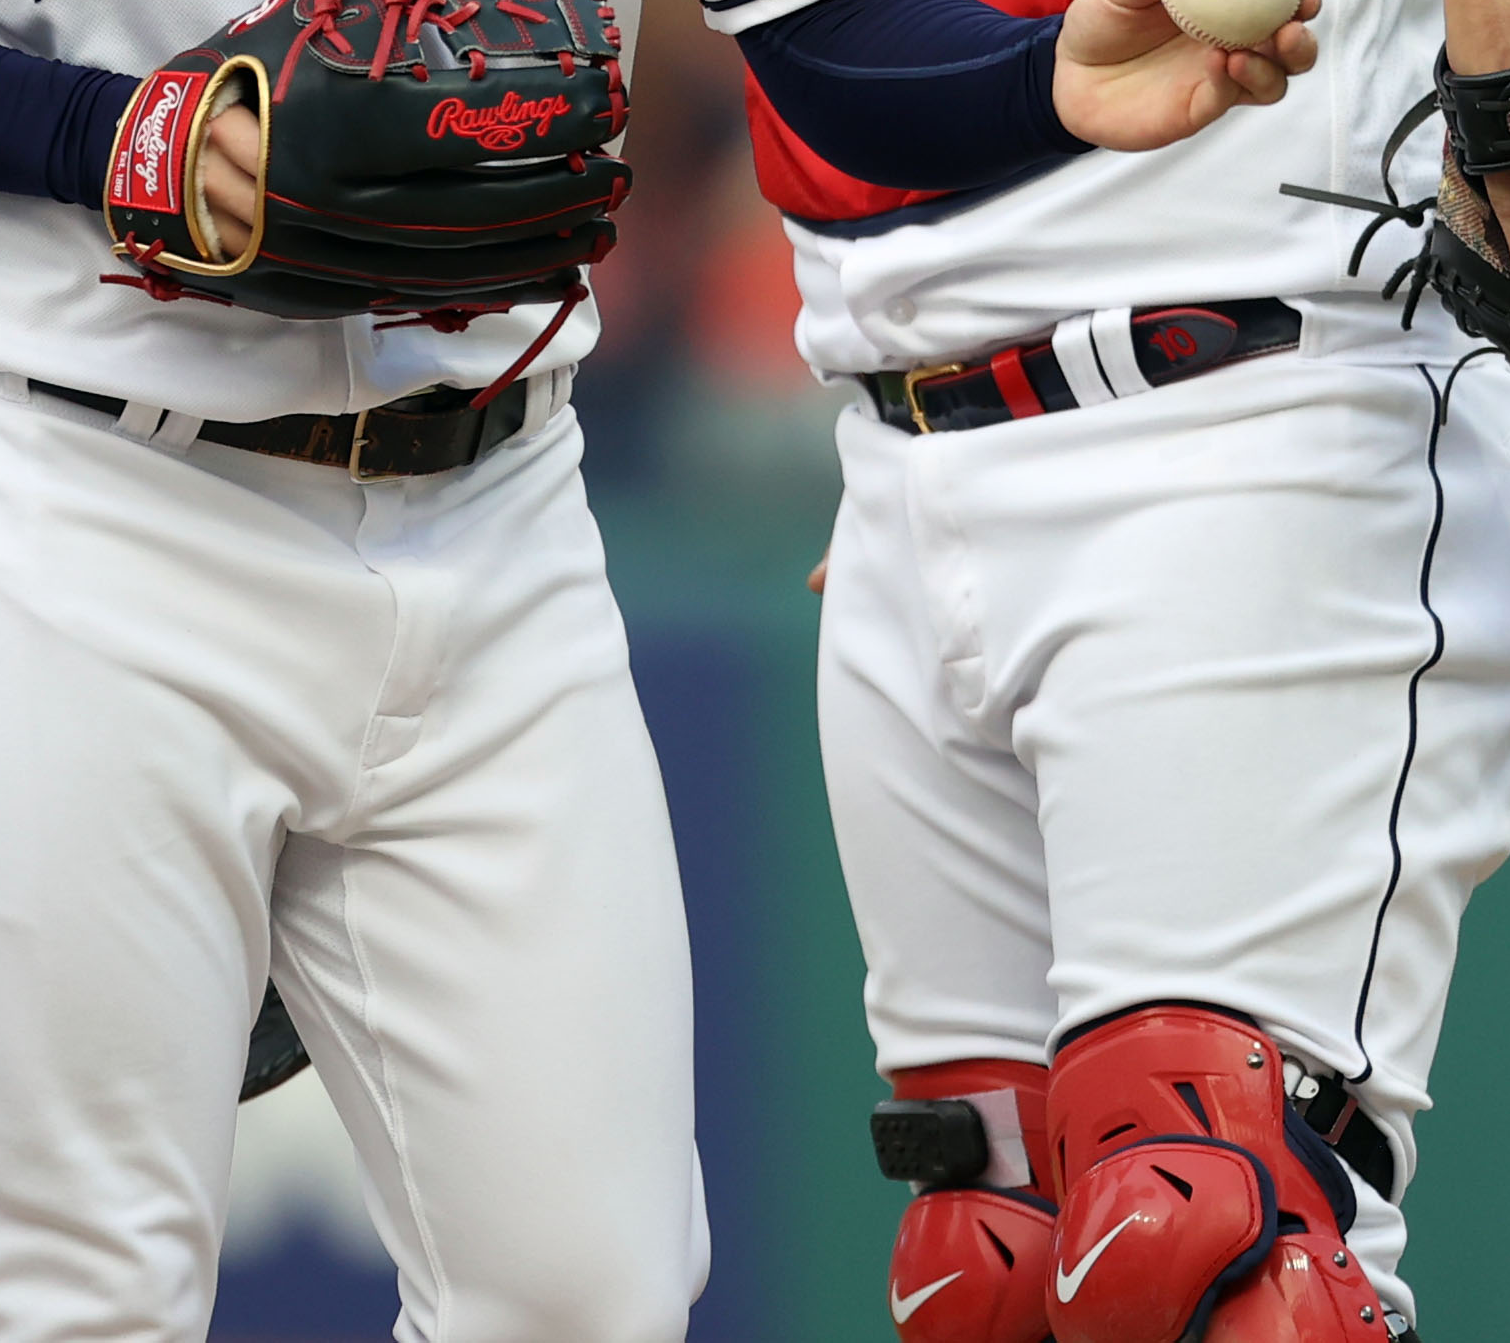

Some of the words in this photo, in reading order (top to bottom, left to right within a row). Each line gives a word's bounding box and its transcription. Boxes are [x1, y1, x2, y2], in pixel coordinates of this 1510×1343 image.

[134, 81, 182, 198] Rawlings
[425, 90, 573, 140] Rawlings
[1148, 325, 1198, 362] 10
